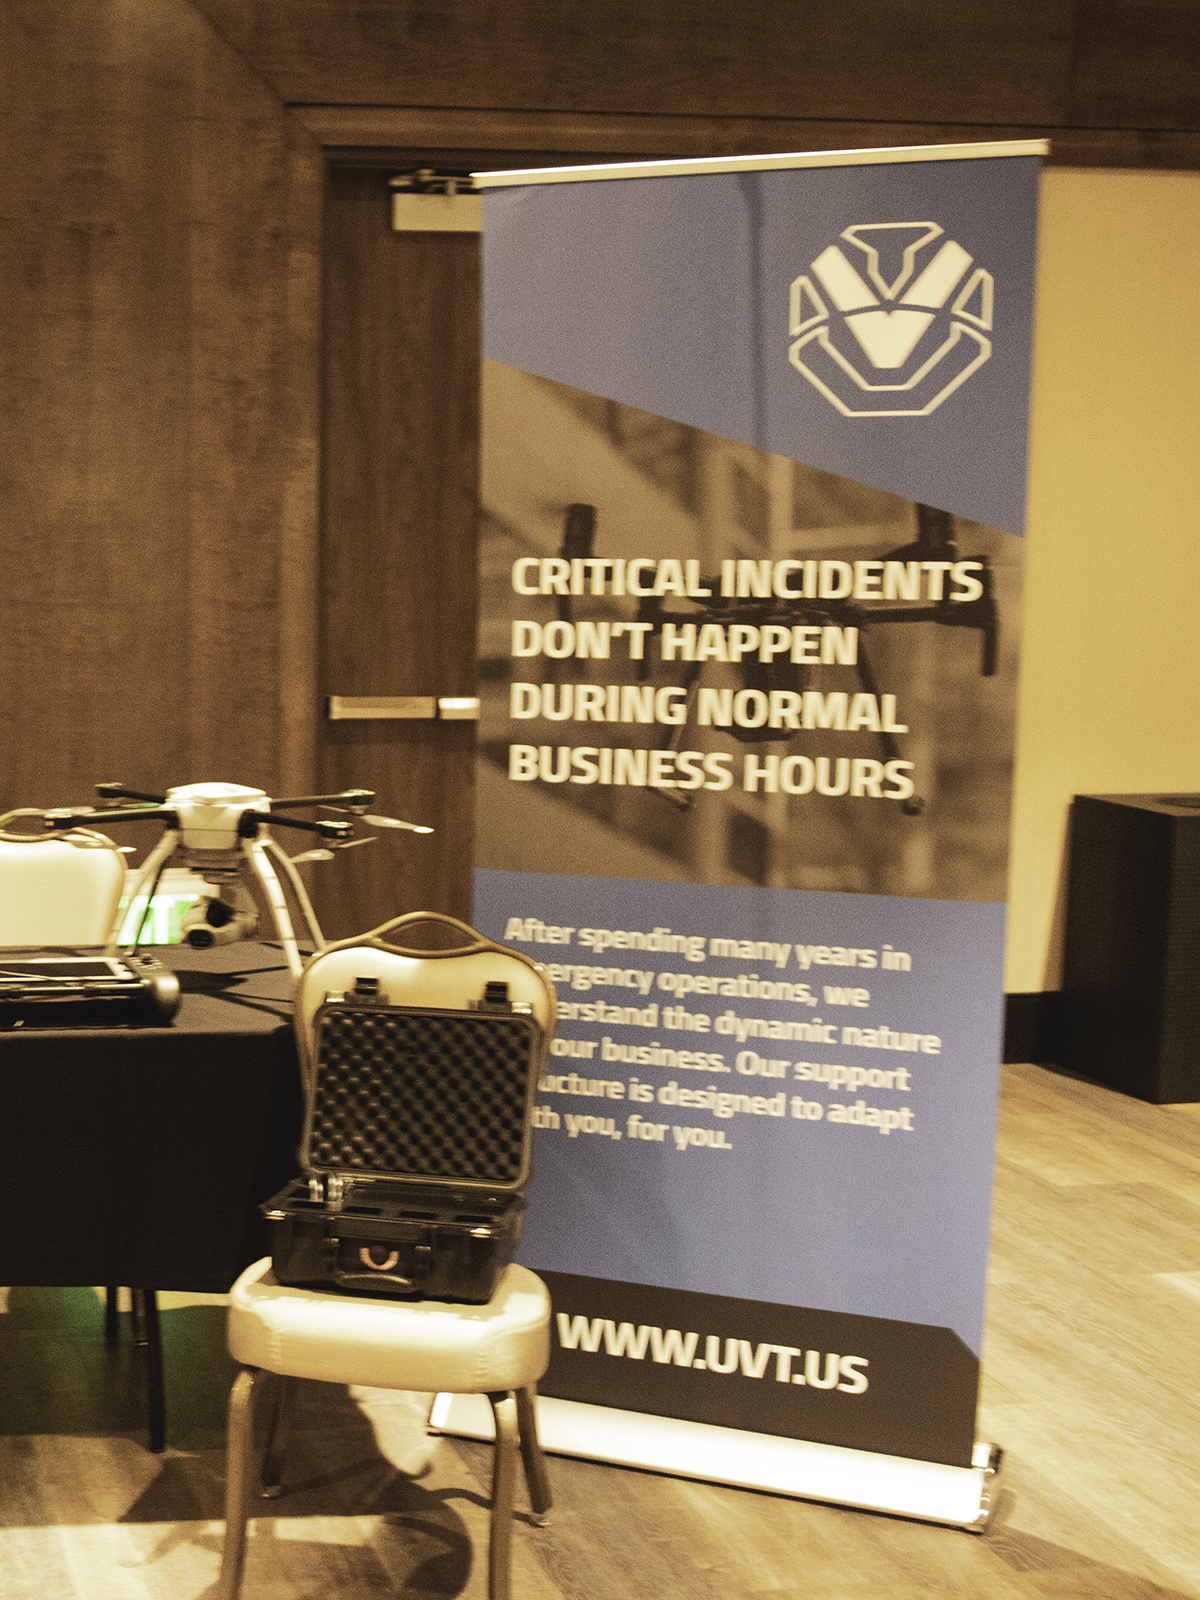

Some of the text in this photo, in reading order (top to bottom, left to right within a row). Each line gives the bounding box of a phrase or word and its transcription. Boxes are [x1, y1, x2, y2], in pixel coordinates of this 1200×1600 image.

[511, 556, 984, 602] CRITICAL INCIDENTS
[511, 619, 858, 666] DON'T HAPPEN
[510, 682, 909, 734] DURING NORMAL
[509, 744, 915, 800] BUSINESS HOURS
[504, 917, 912, 972] After spending many years in
[547, 963, 870, 1008] ergency operations, we
[556, 1000, 942, 1055] erstand the dynamic nature
[602, 1036, 732, 1074] business.
[735, 1050, 792, 1079] Our
[794, 1061, 912, 1092] support
[539, 1072, 915, 1135] ucture is designed to adapt
[565, 1114, 623, 1141] you,
[627, 1114, 671, 1142] for
[672, 1125, 733, 1151] you.
[557, 1312, 870, 1395] WWW.UVT.US
